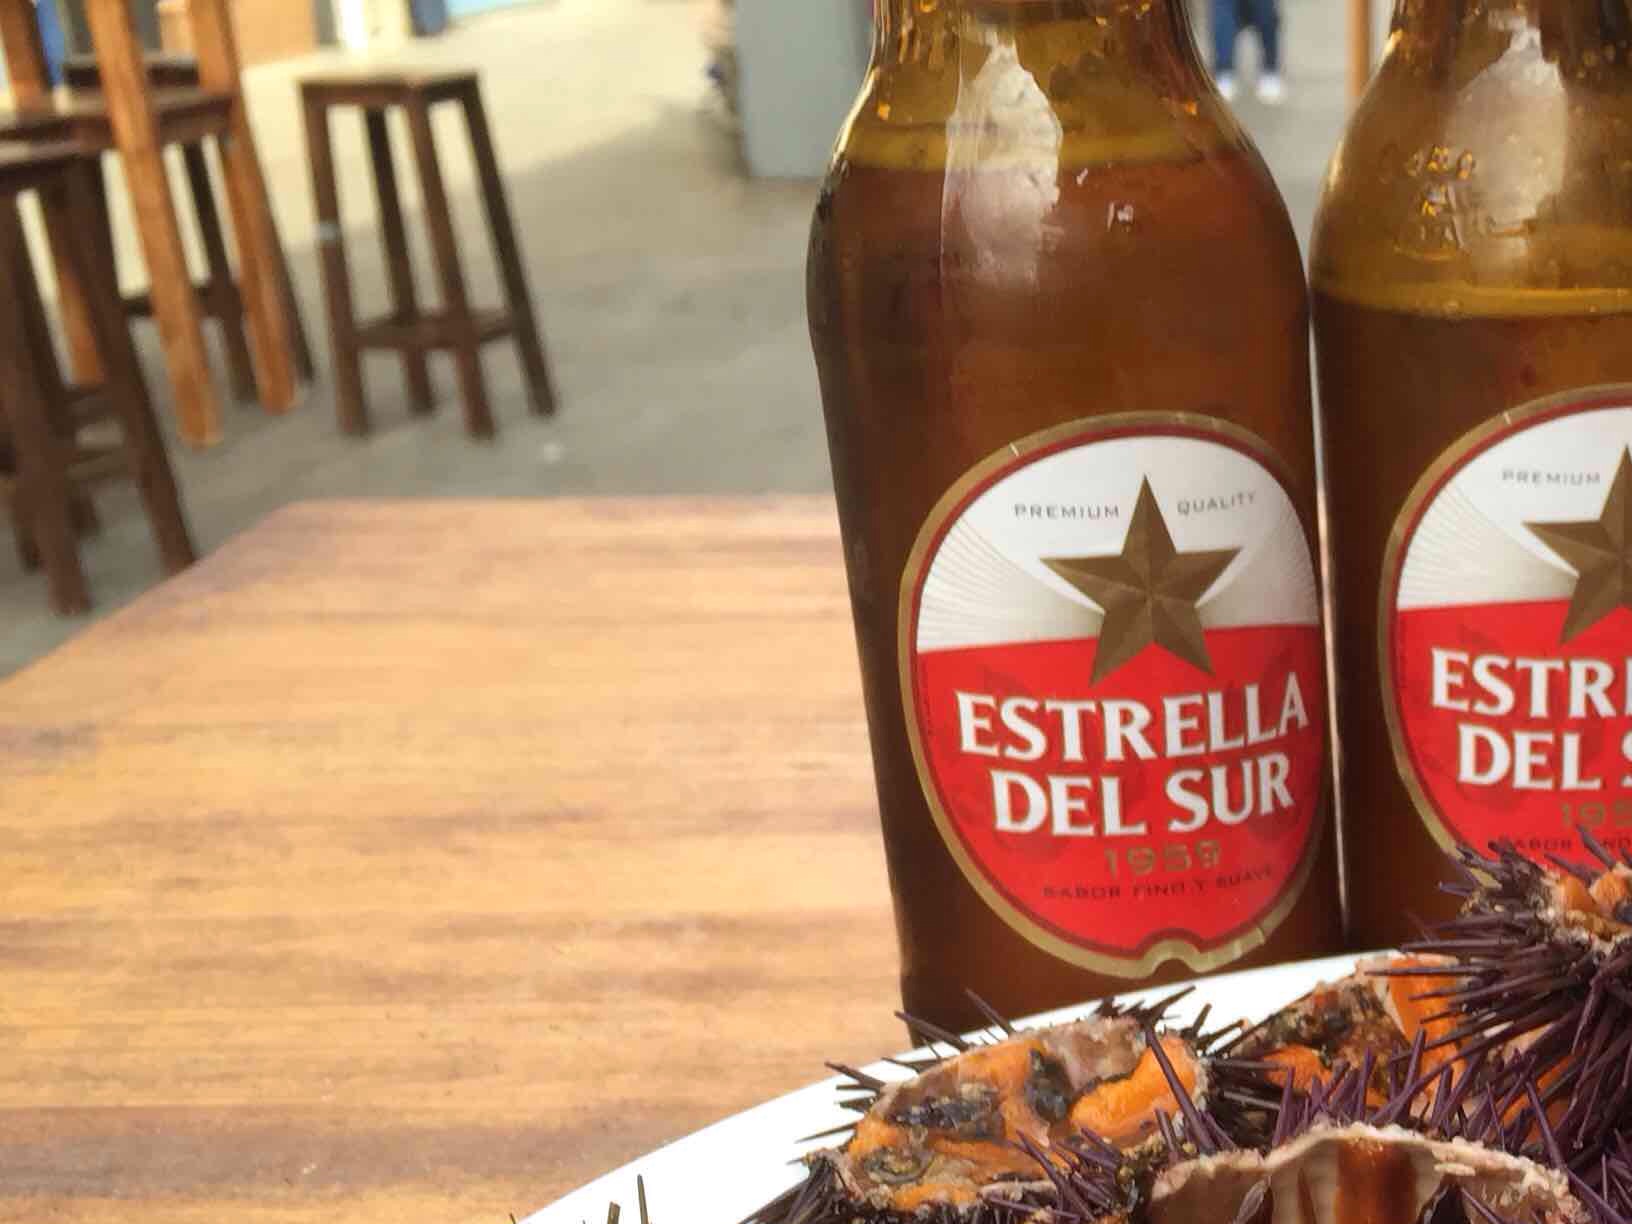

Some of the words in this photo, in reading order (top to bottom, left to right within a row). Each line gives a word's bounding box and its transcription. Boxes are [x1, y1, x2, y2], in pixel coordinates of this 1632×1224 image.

[1013, 503, 1120, 520] PREMIUM
[1176, 491, 1257, 516] QUALITY
[1501, 468, 1601, 486] PREMIUM
[954, 671, 1309, 764] ESTRELLA
[1457, 723, 1602, 791] DEL
[991, 769, 1147, 838] DEL
[1165, 751, 1295, 834] SUR
